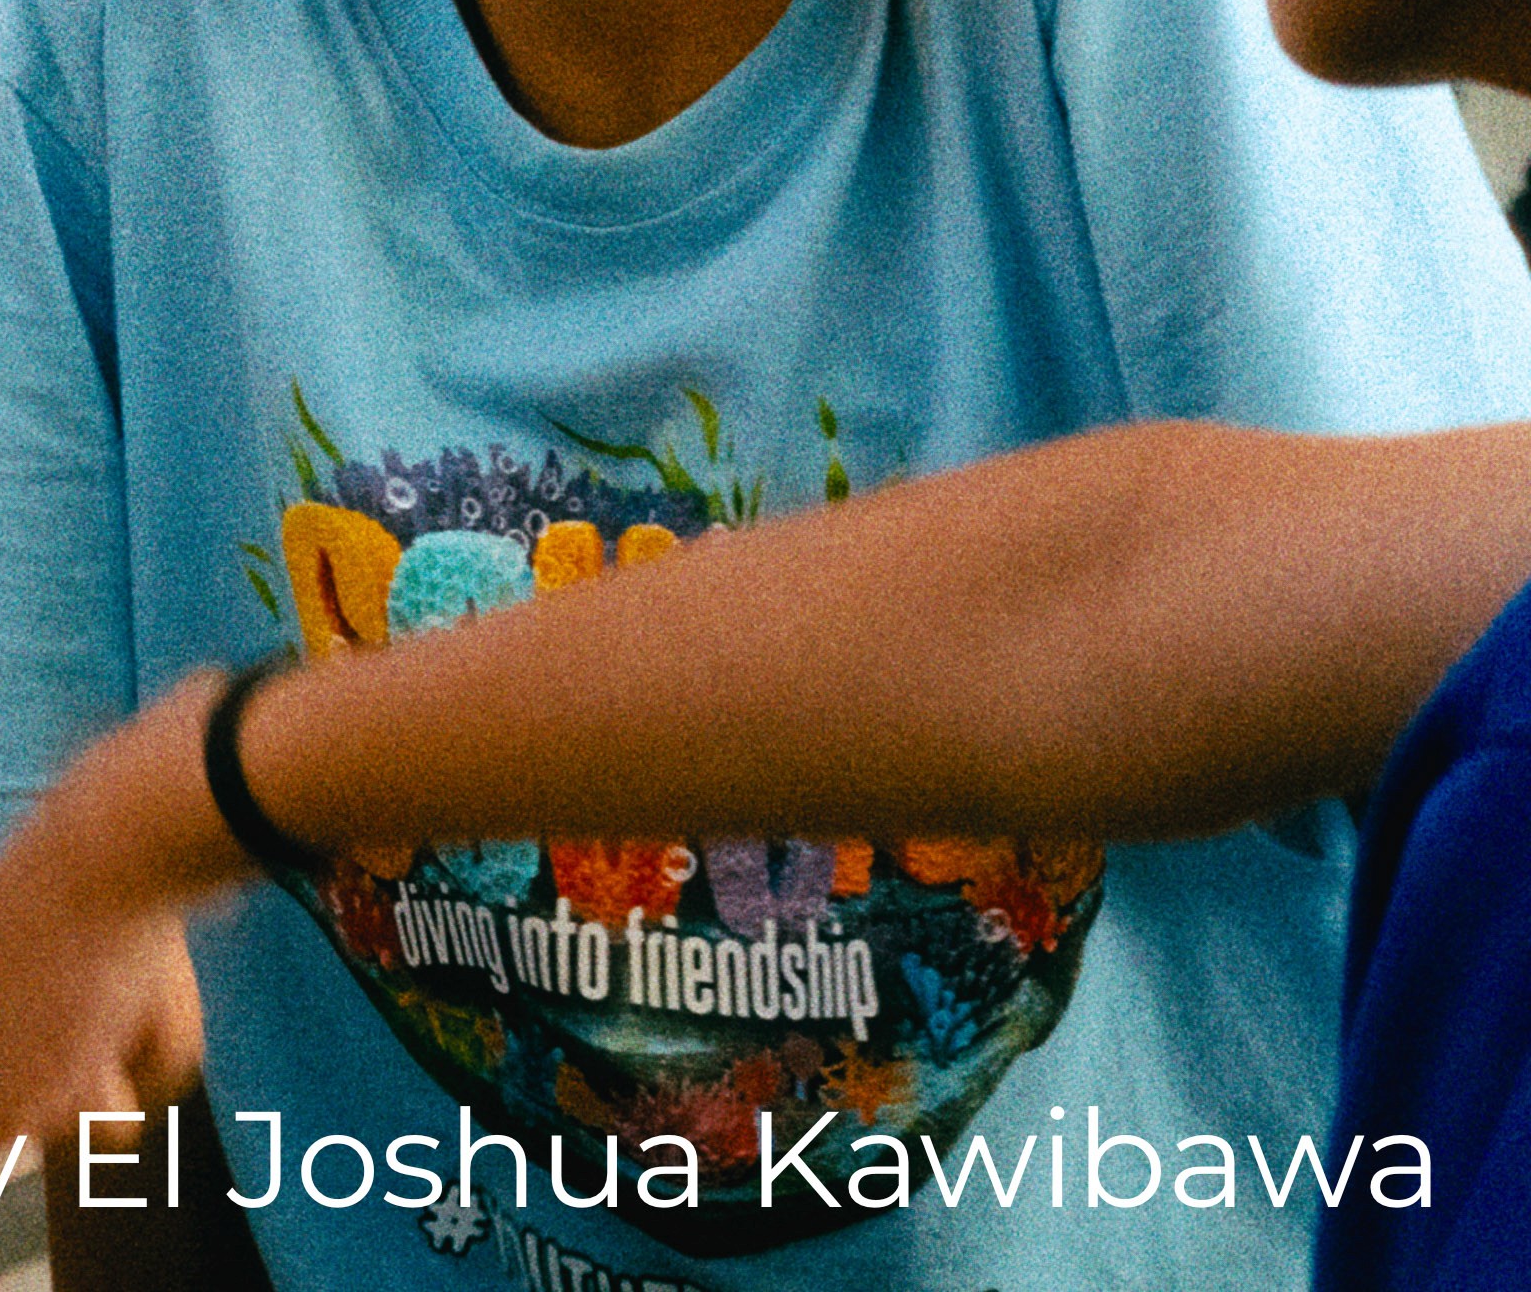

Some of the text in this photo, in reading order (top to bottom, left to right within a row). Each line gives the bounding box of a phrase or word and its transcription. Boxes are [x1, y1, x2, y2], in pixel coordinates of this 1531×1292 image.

[393, 880, 880, 1042] diving into friendship
